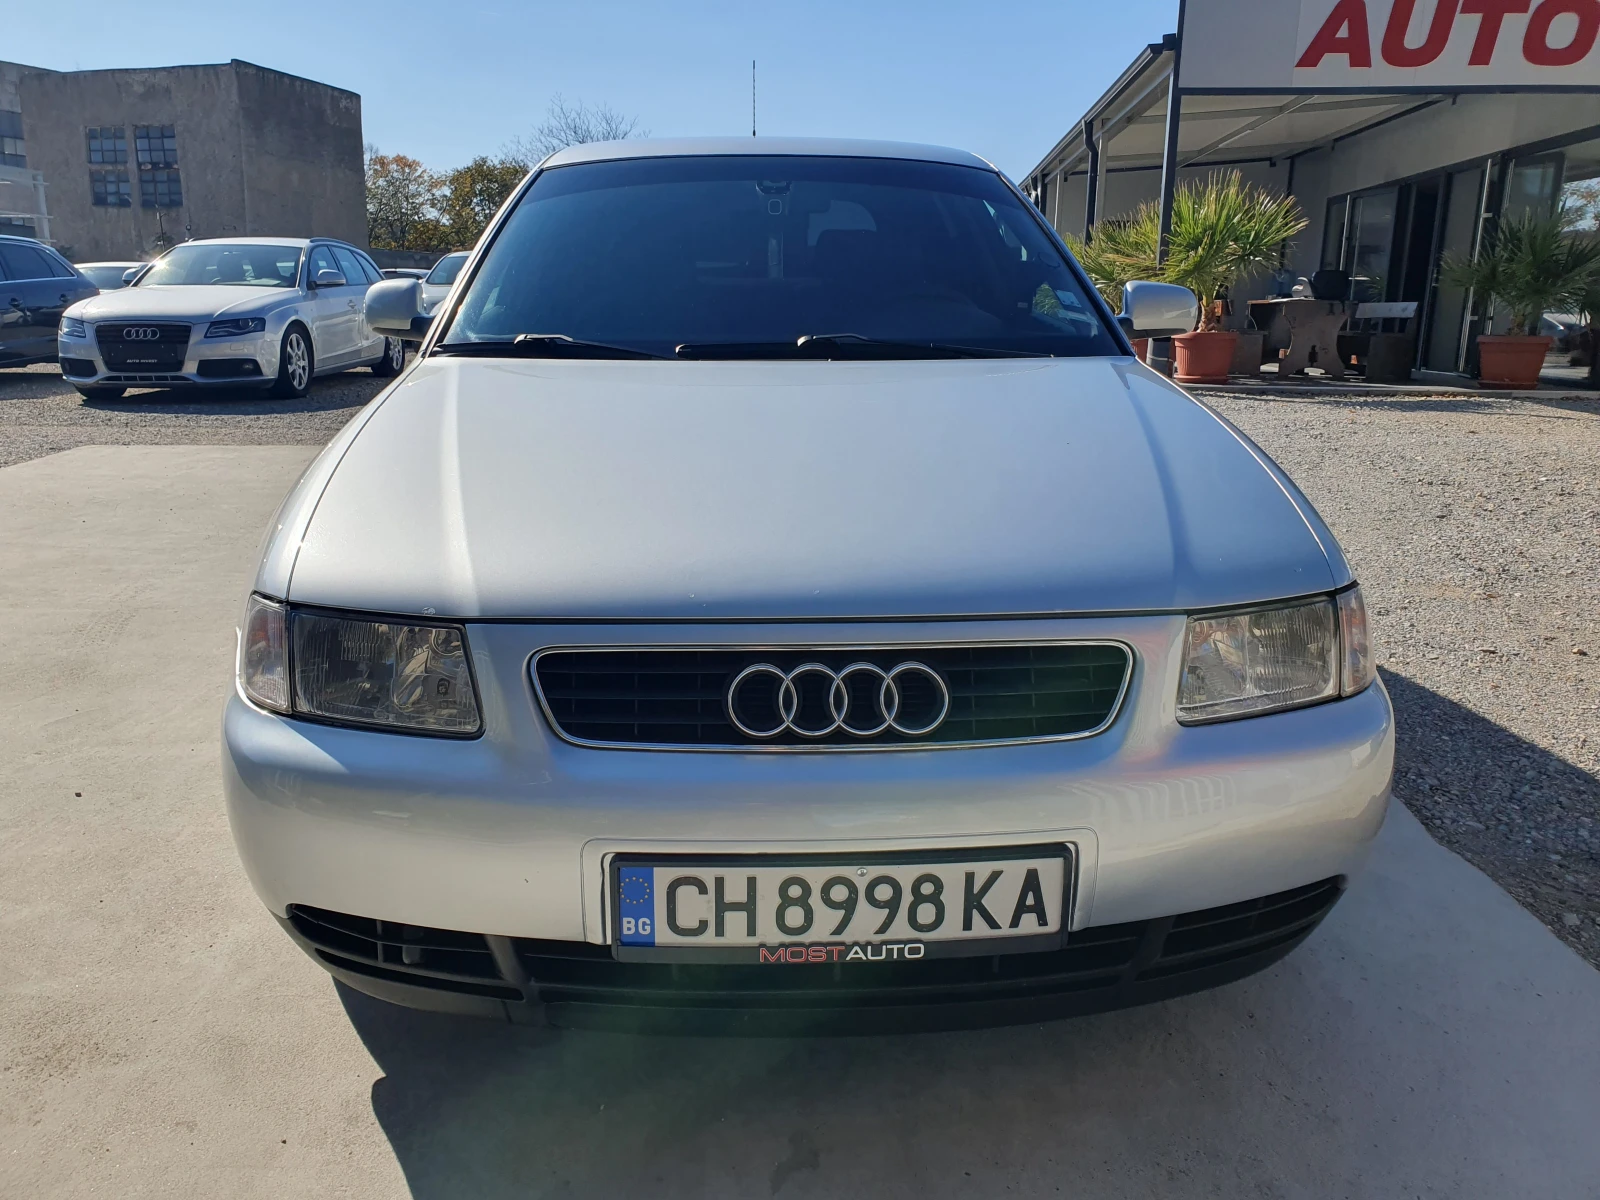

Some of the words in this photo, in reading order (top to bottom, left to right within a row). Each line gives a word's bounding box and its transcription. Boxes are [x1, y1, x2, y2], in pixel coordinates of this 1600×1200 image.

[1294, 0, 1600, 68] AUTO
[622, 917, 651, 935] BG
[666, 876, 757, 937] CH
[775, 873, 945, 936] 8998
[962, 868, 1048, 931] KA
